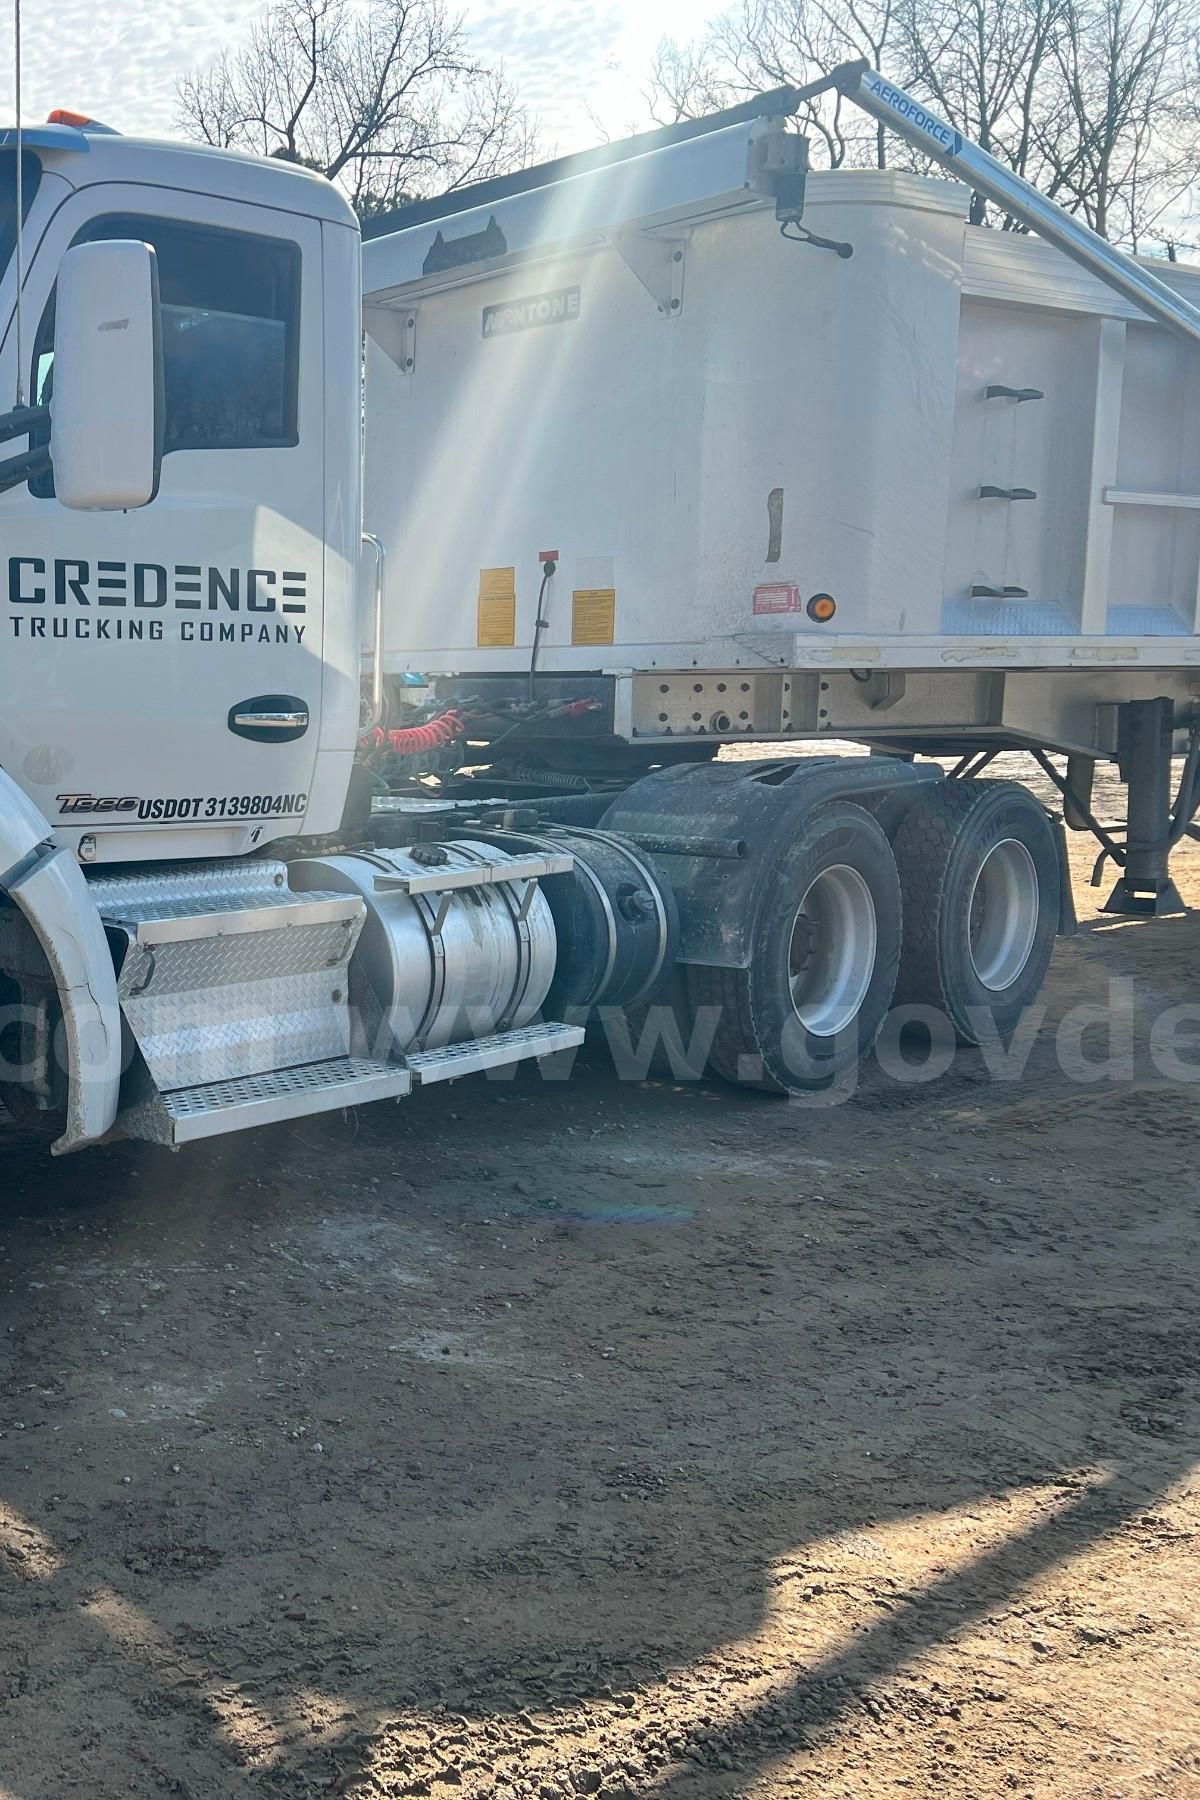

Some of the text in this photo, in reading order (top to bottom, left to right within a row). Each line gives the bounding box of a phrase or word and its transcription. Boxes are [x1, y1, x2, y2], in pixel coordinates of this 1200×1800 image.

[870, 81, 952, 145] AEROFORCE
[8, 556, 307, 613] CREDENCE
[9, 616, 306, 643] TRUCKING COMPANY
[56, 793, 140, 813] T880
[137, 793, 307, 820] USDOT 3139804NC
